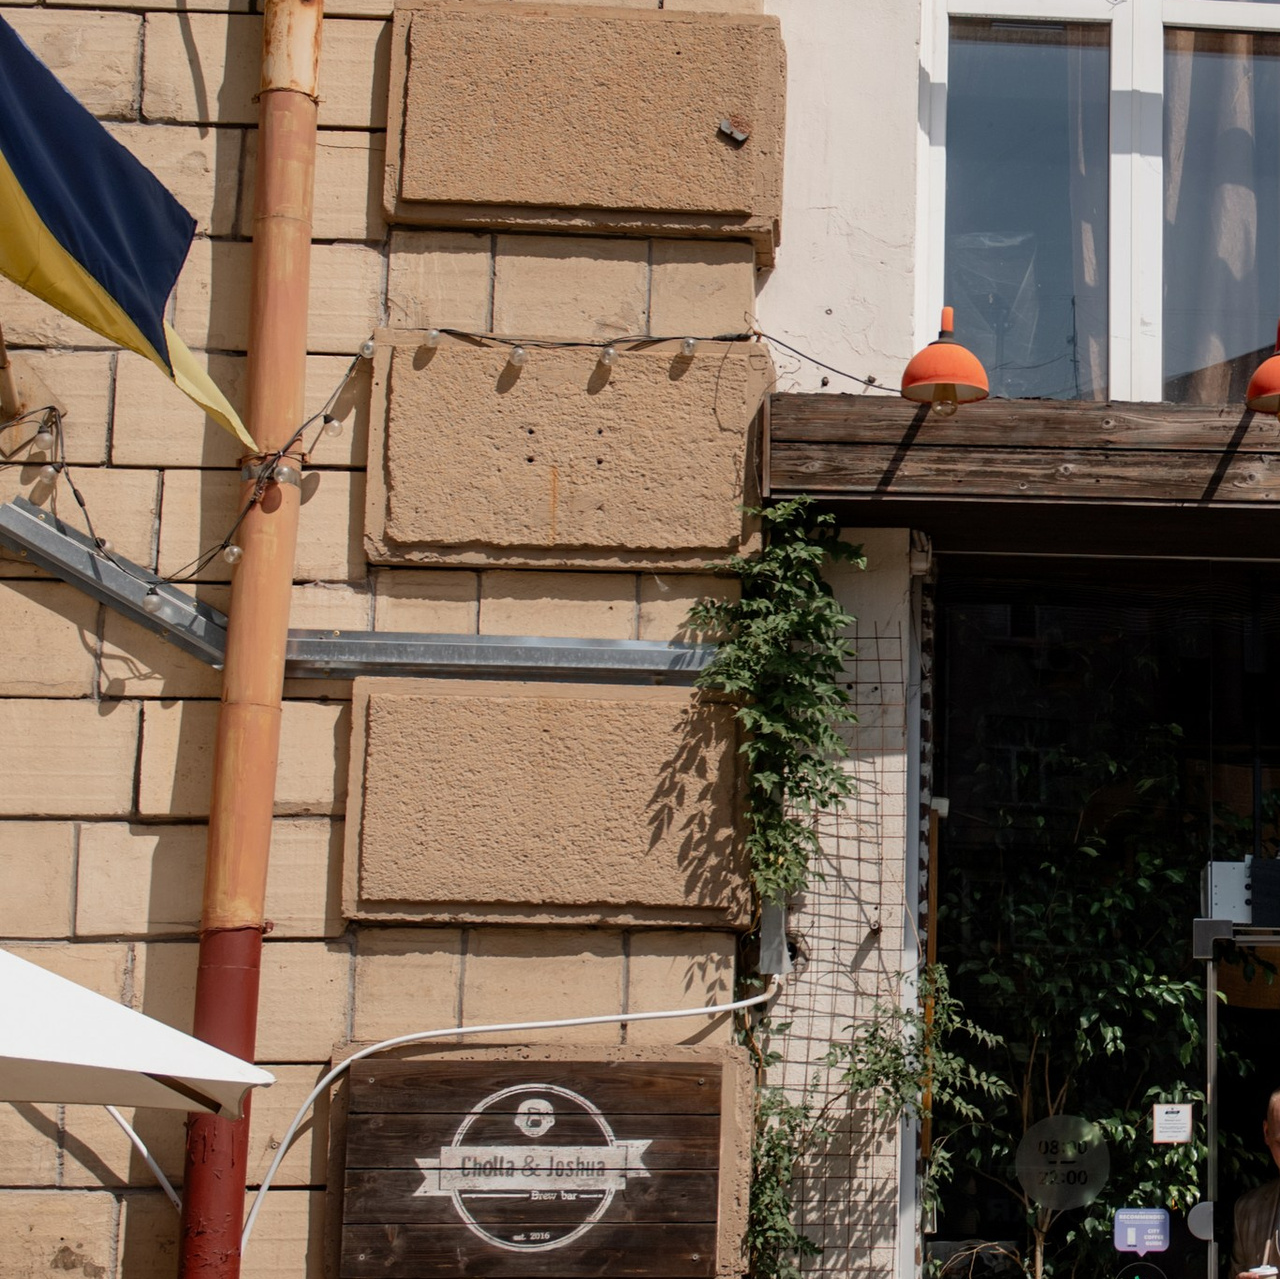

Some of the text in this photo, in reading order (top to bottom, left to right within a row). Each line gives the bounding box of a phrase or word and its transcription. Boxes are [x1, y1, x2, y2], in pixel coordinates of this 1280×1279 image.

[461, 1155, 606, 1178] Cholla & Joshua
[531, 1190, 577, 1201] Brew bar
[530, 1231, 550, 1240] 2016
